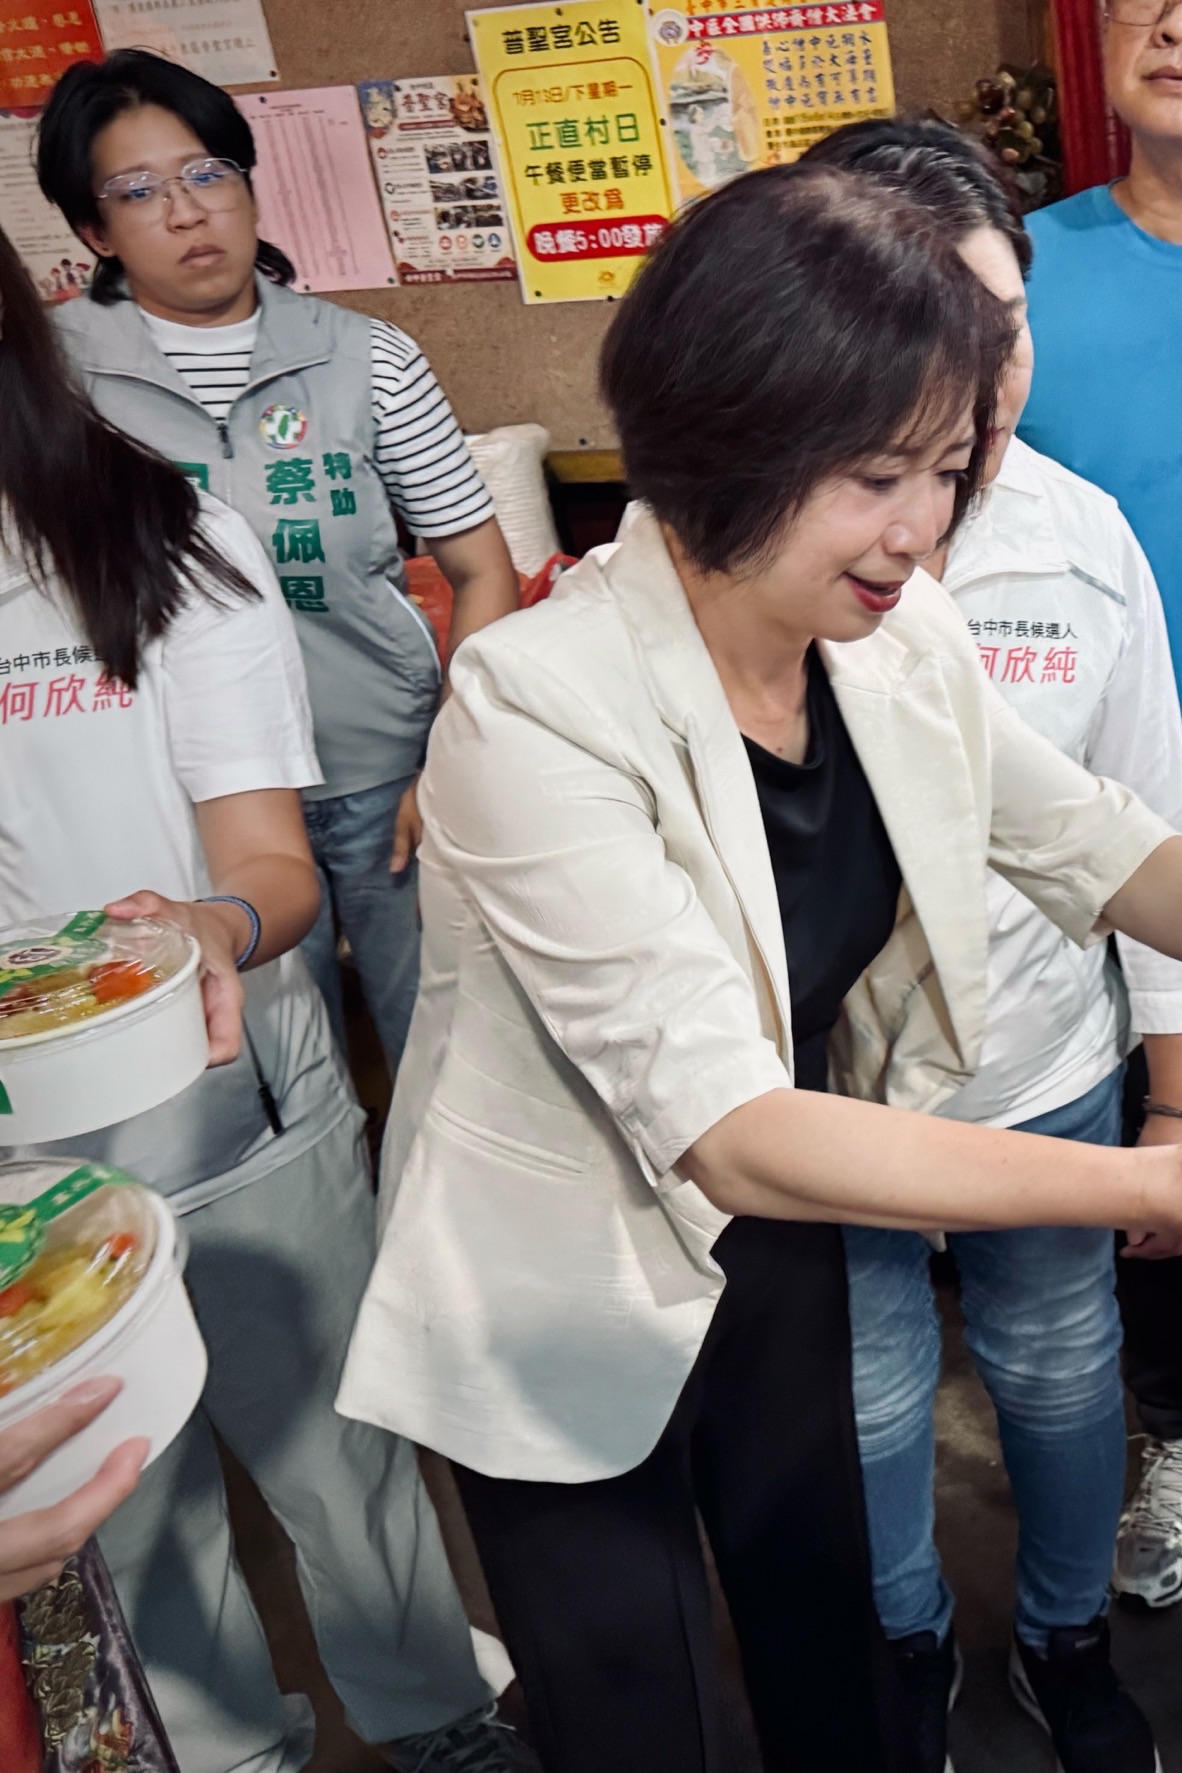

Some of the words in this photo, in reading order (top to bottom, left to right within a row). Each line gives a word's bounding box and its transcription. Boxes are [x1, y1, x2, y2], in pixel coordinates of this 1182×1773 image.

[501, 19, 621, 55] 普聖宮公告
[525, 112, 641, 150] 正直村日
[524, 154, 653, 186] 午餐便當暫停
[322, 452, 357, 516] 特助
[967, 618, 1078, 640] 台中市長候選人
[0, 645, 104, 676] 台中市長候
